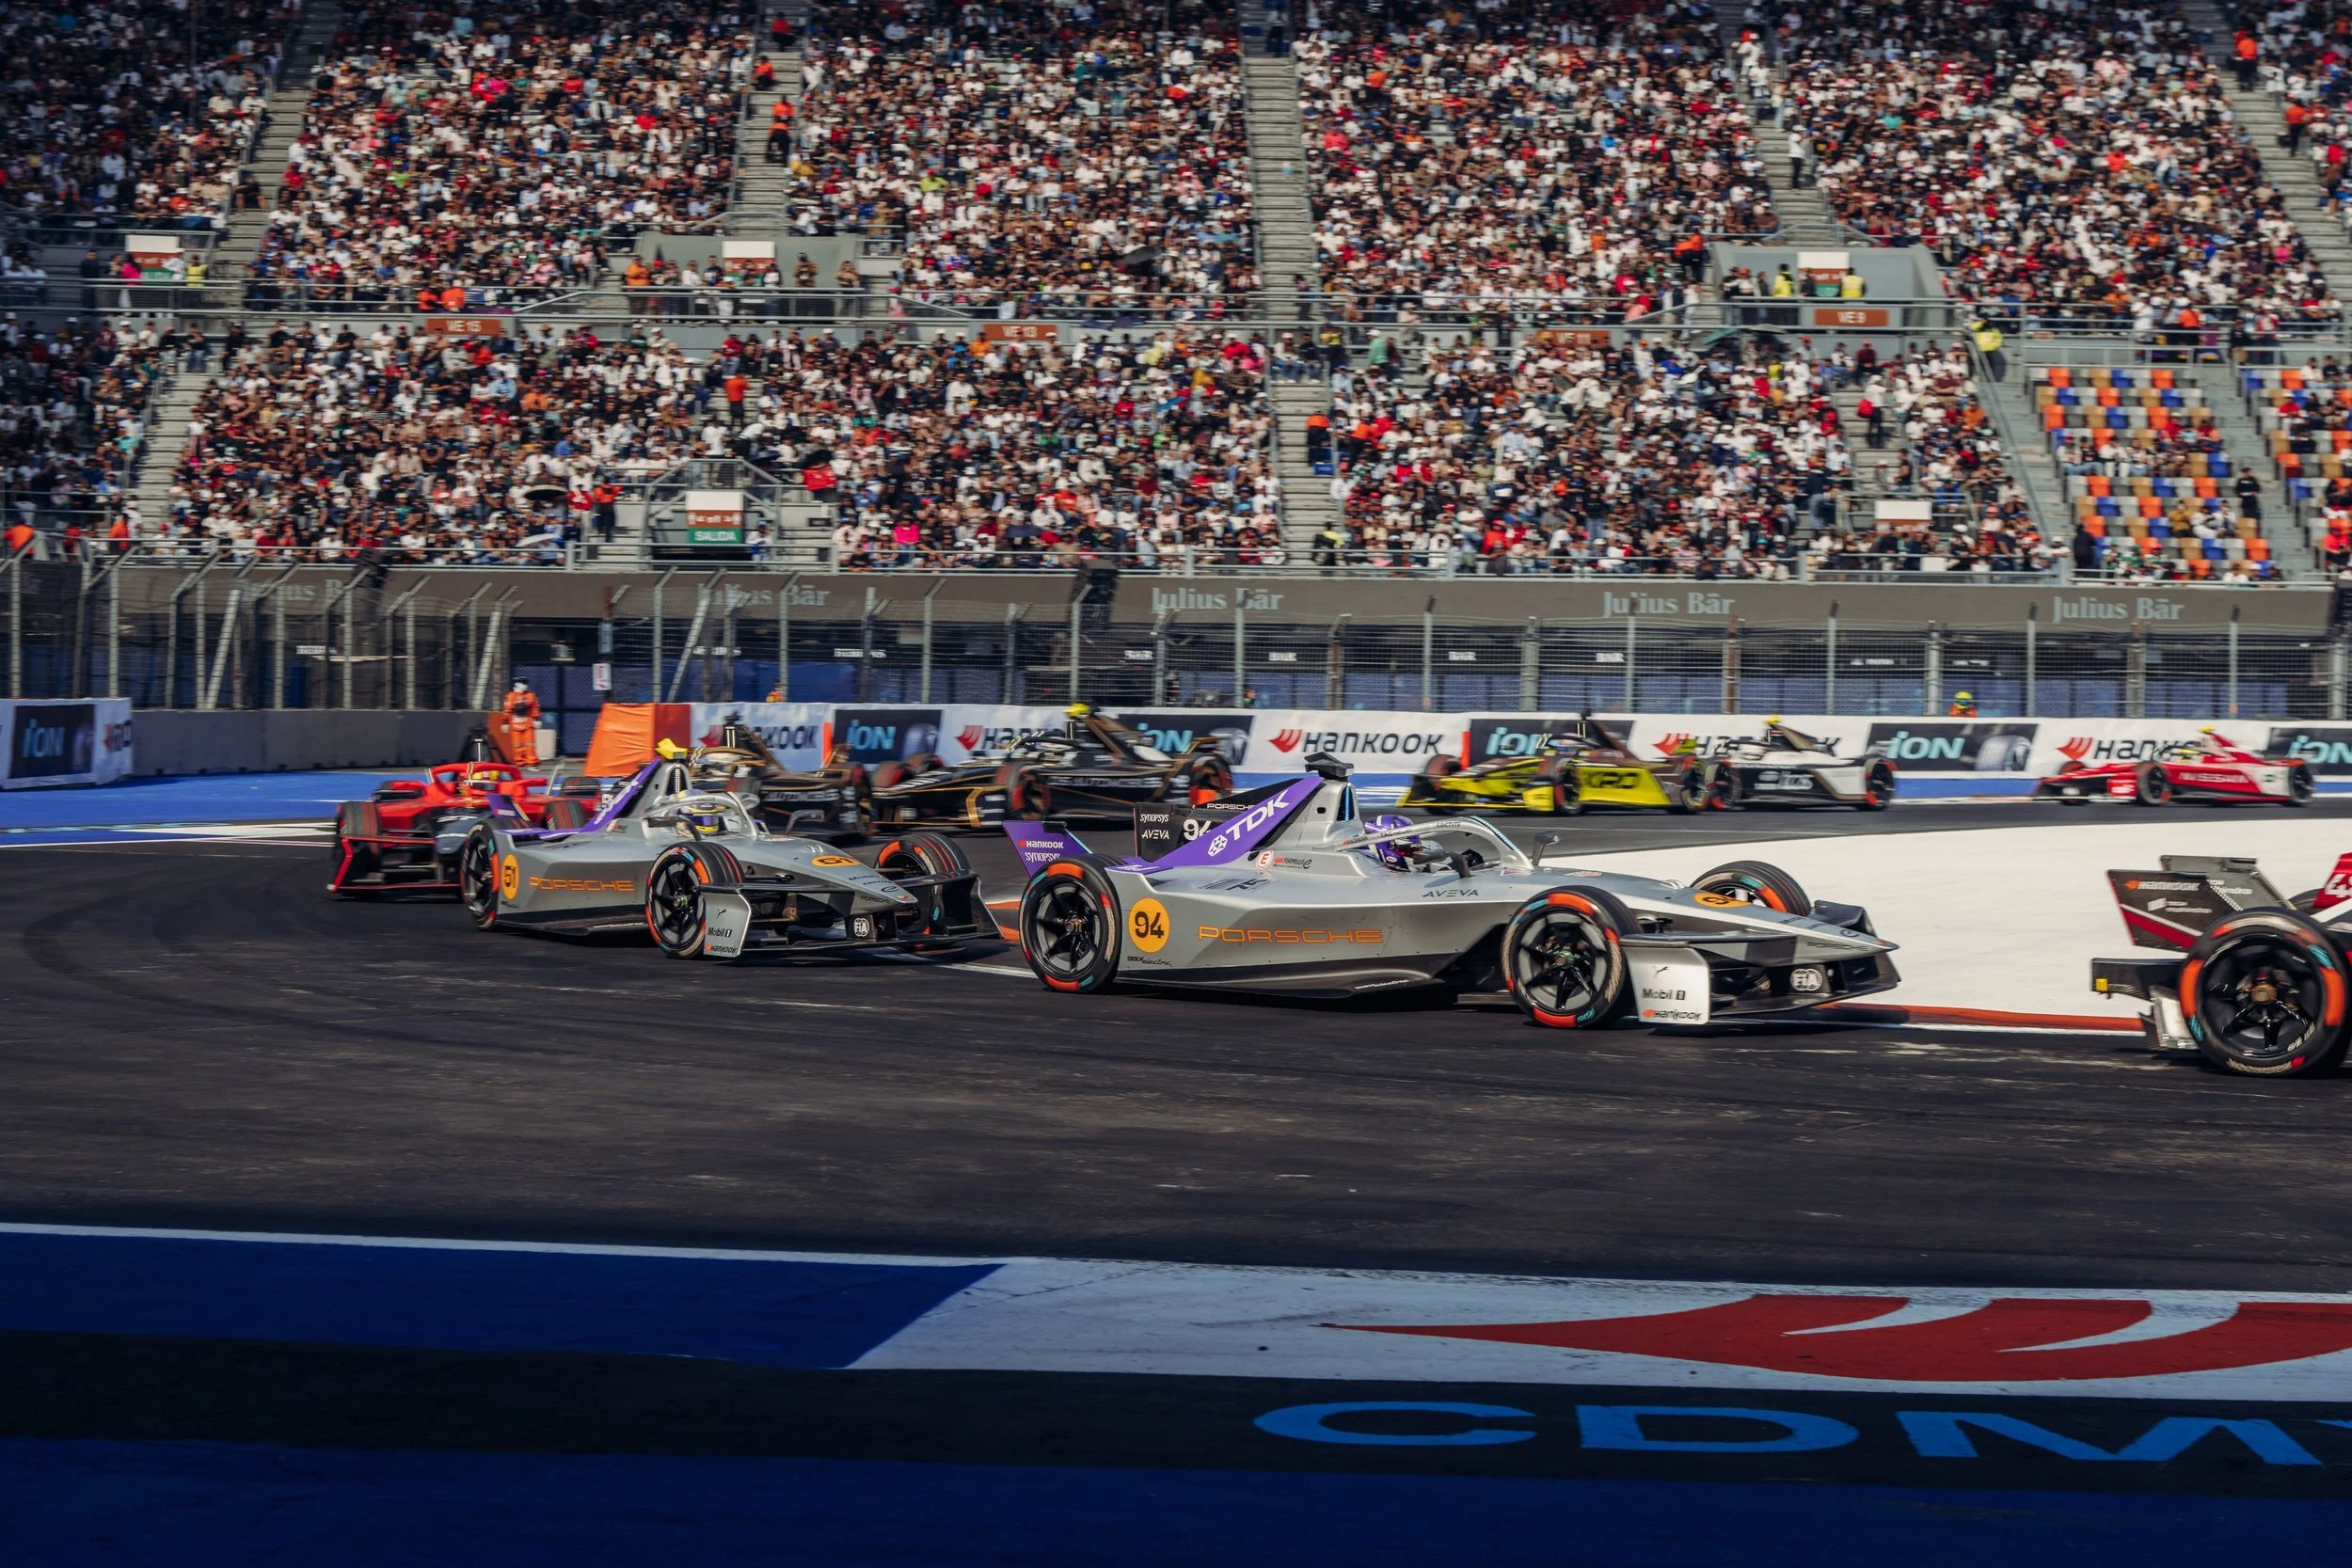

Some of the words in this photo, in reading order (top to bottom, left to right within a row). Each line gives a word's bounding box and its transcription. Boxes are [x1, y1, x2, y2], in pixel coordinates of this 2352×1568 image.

[693, 531, 738, 542] SALIDA
[2052, 596, 2128, 623] Julius
[2137, 596, 2185, 620] Bär
[1226, 789, 1290, 841] TDK
[1141, 829, 1170, 840] AVEVA
[503, 865, 517, 888] 51
[529, 875, 636, 892] PORSCHE
[1422, 889, 1478, 897] AVEVA
[2325, 873, 2352, 899] 4
[707, 927, 724, 937] Mobil
[1134, 910, 1165, 939] 94
[1198, 926, 1384, 944] PORSCHE
[1642, 988, 1672, 1000] Mobil
[1255, 1400, 2352, 1466] CDM
